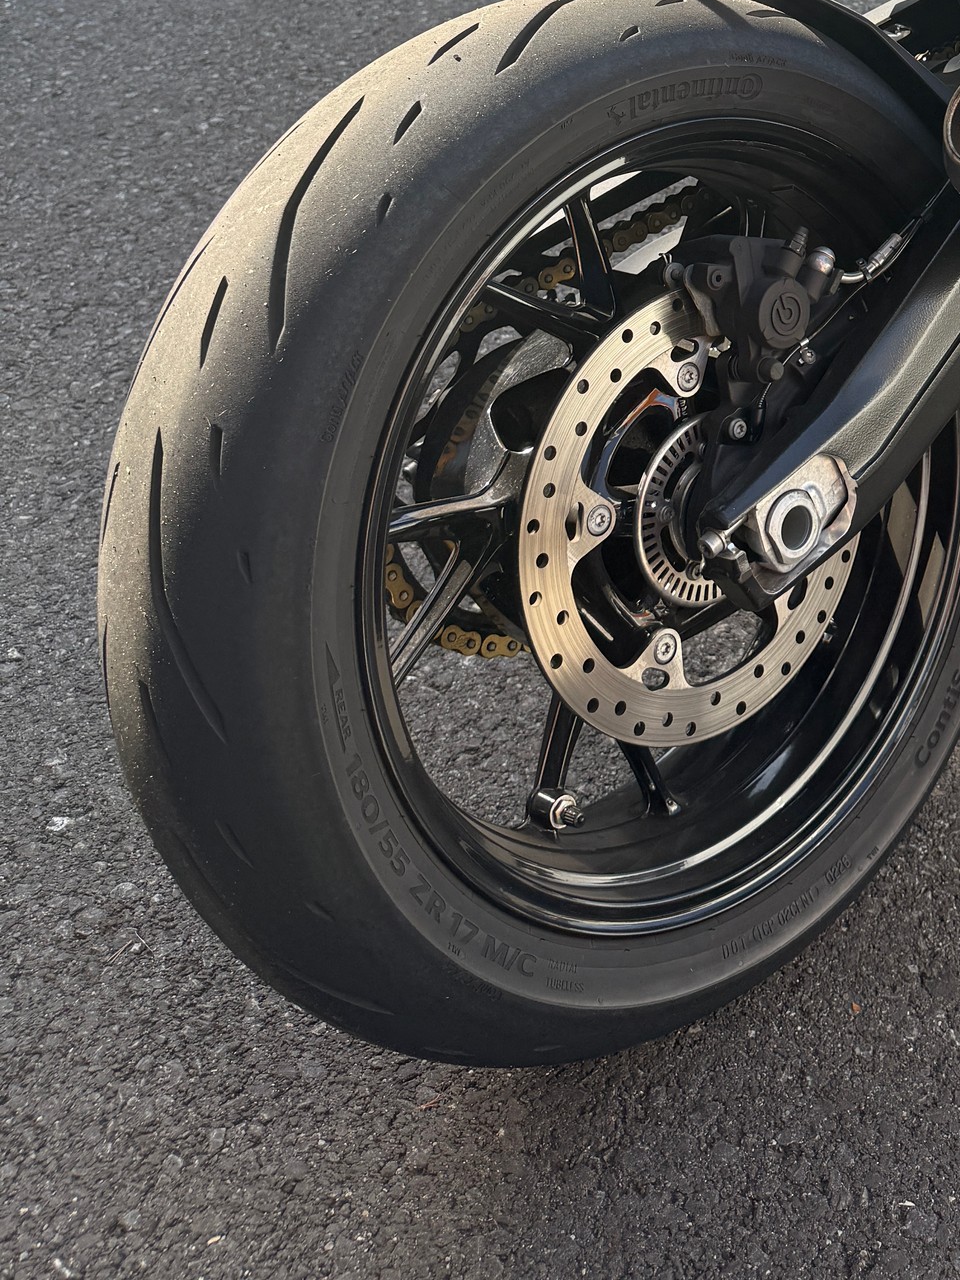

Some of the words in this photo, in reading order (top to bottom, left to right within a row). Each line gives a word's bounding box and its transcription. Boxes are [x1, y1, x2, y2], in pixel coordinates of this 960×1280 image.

[629, 72, 764, 120] Continental
[334, 687, 352, 741] REAR
[345, 752, 412, 878] 180/55
[409, 872, 447, 924] ZR
[450, 910, 480, 947] 17
[481, 933, 538, 978] M/C
